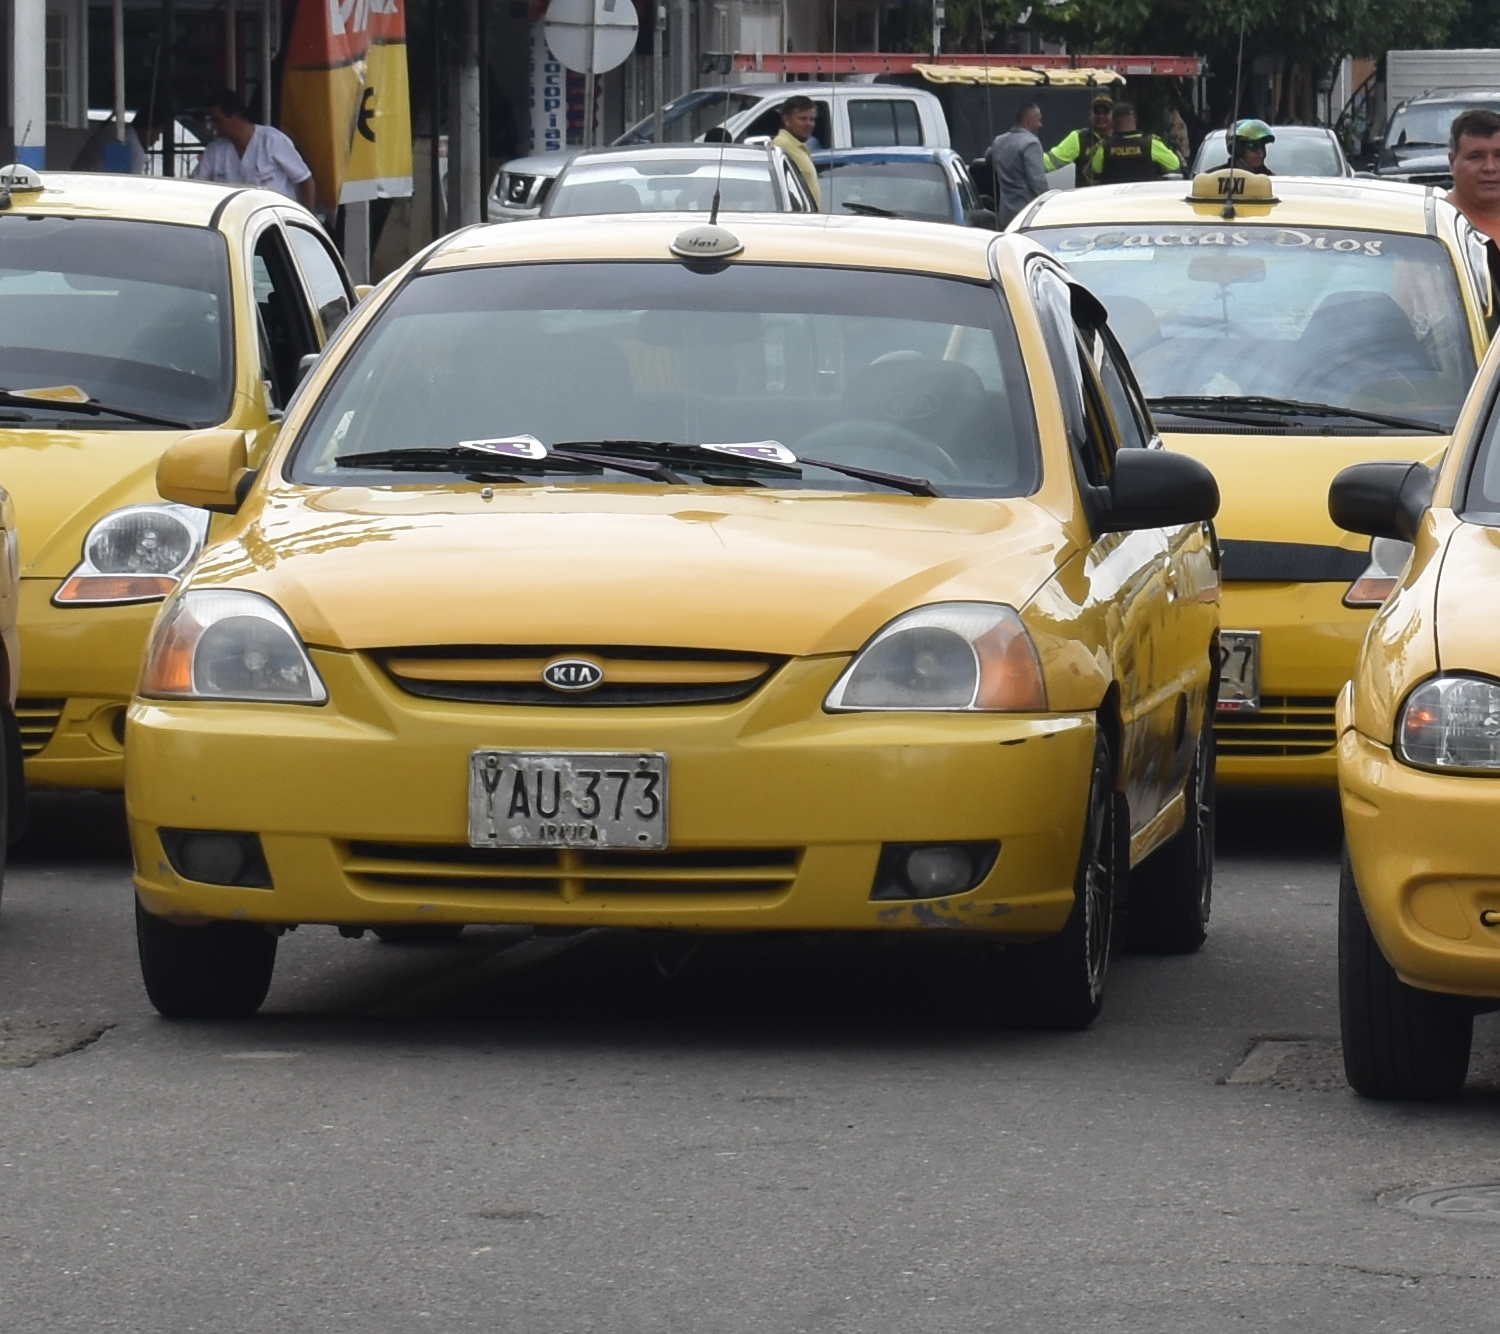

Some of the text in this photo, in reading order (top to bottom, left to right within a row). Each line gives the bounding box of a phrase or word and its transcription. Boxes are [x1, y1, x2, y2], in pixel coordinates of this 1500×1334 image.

[1217, 176, 1246, 195] TAXI
[553, 667, 593, 682] KIA
[479, 767, 660, 821] YAU 373
